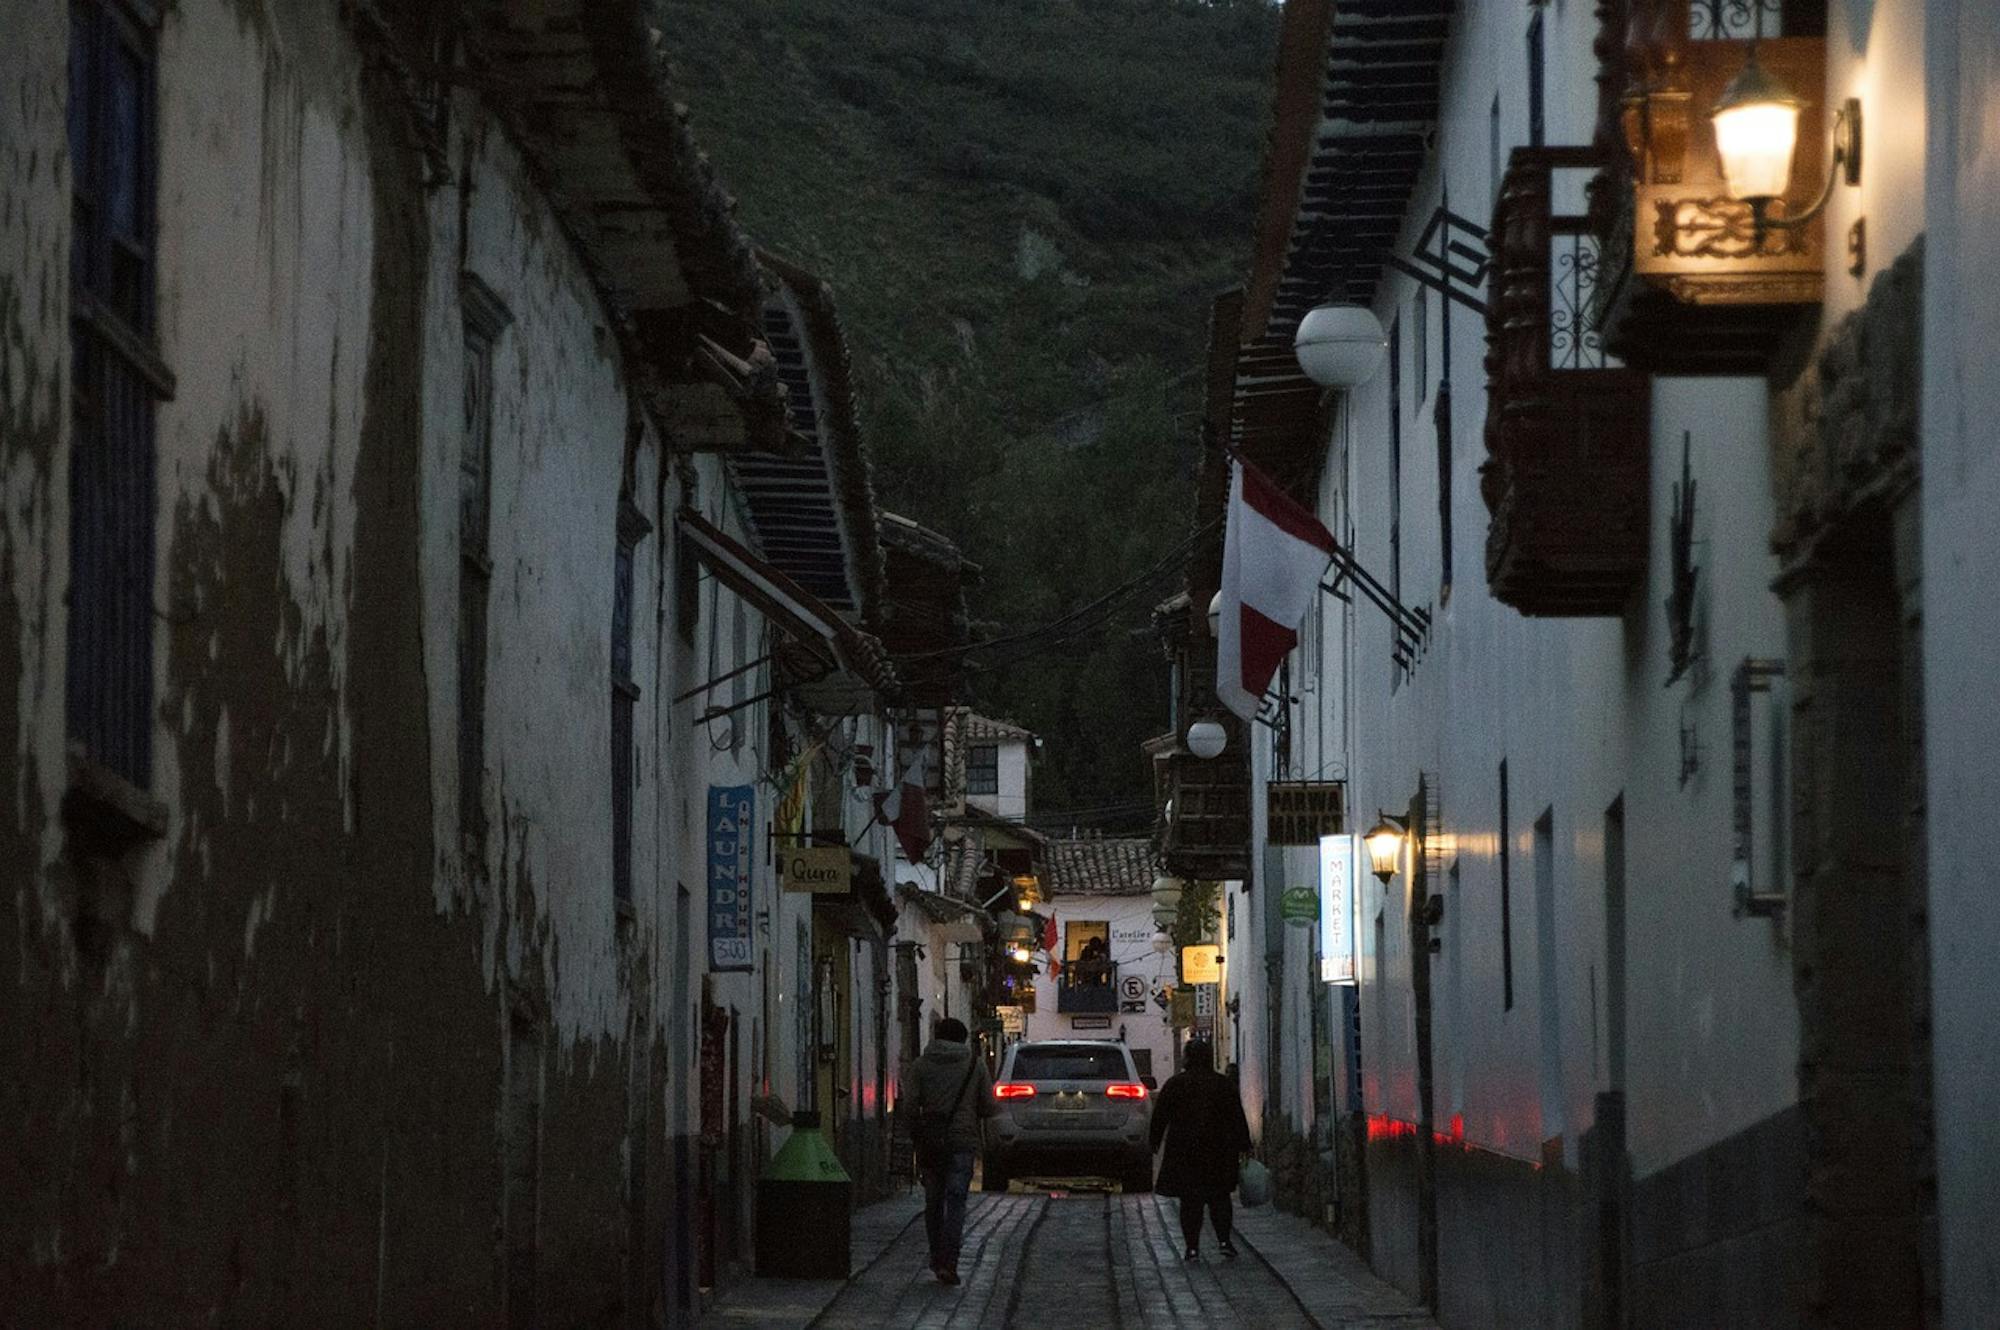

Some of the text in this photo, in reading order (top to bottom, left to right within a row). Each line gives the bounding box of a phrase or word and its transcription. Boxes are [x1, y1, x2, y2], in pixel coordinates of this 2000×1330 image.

[1270, 790, 1340, 812] PARWA
[1269, 815, 1342, 844] MARKET
[714, 792, 737, 929] LAUNDR
[1329, 860, 1344, 944] MARKET
